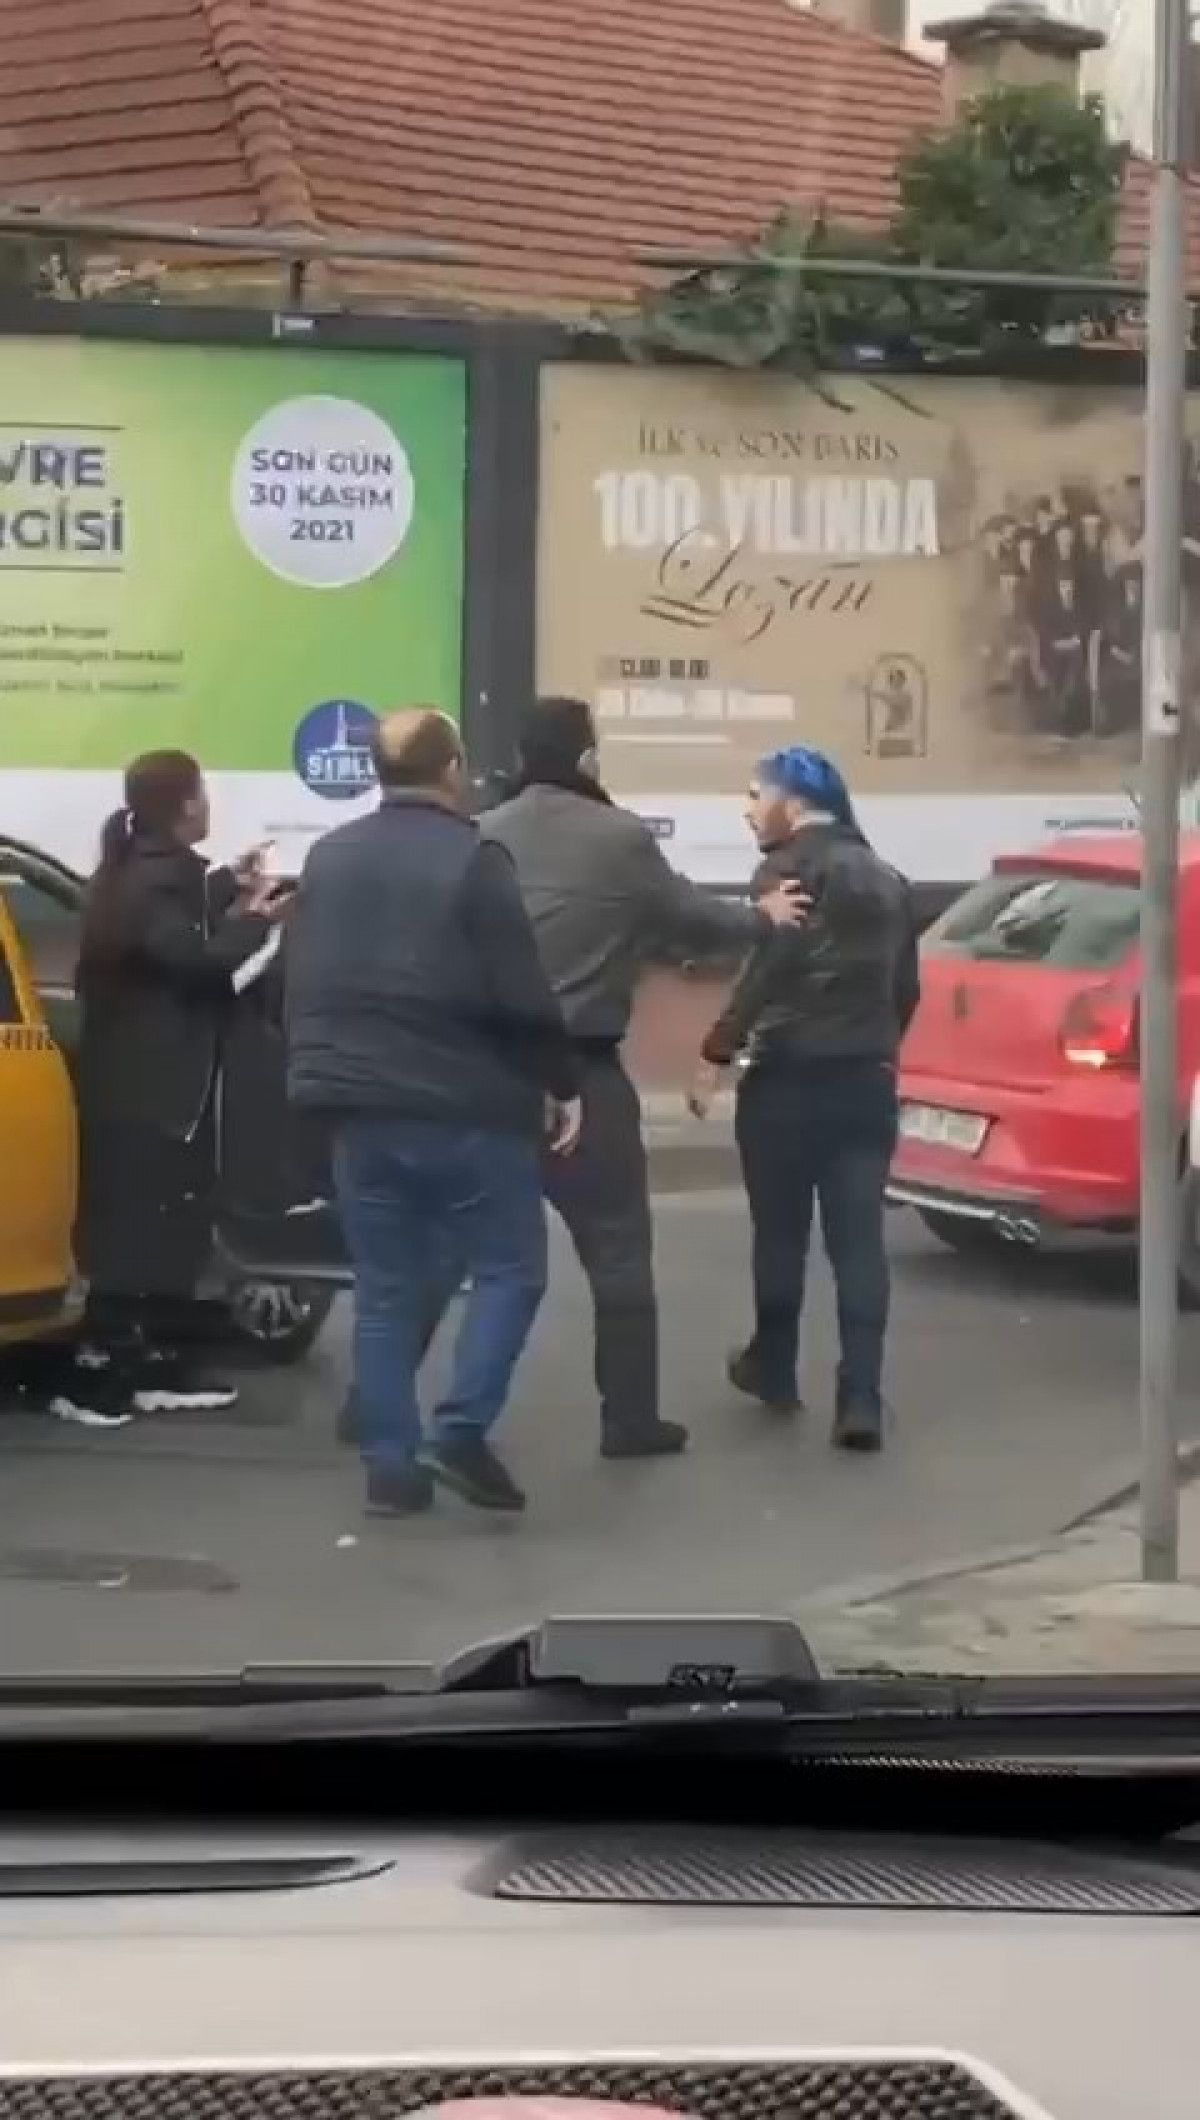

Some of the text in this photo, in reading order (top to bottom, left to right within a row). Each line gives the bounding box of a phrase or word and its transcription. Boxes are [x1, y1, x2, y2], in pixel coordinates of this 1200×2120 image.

[738, 430, 804, 460] SON
[251, 449, 316, 471] SON
[249, 482, 392, 511] 30 KASIM
[290, 519, 354, 541] 2021
